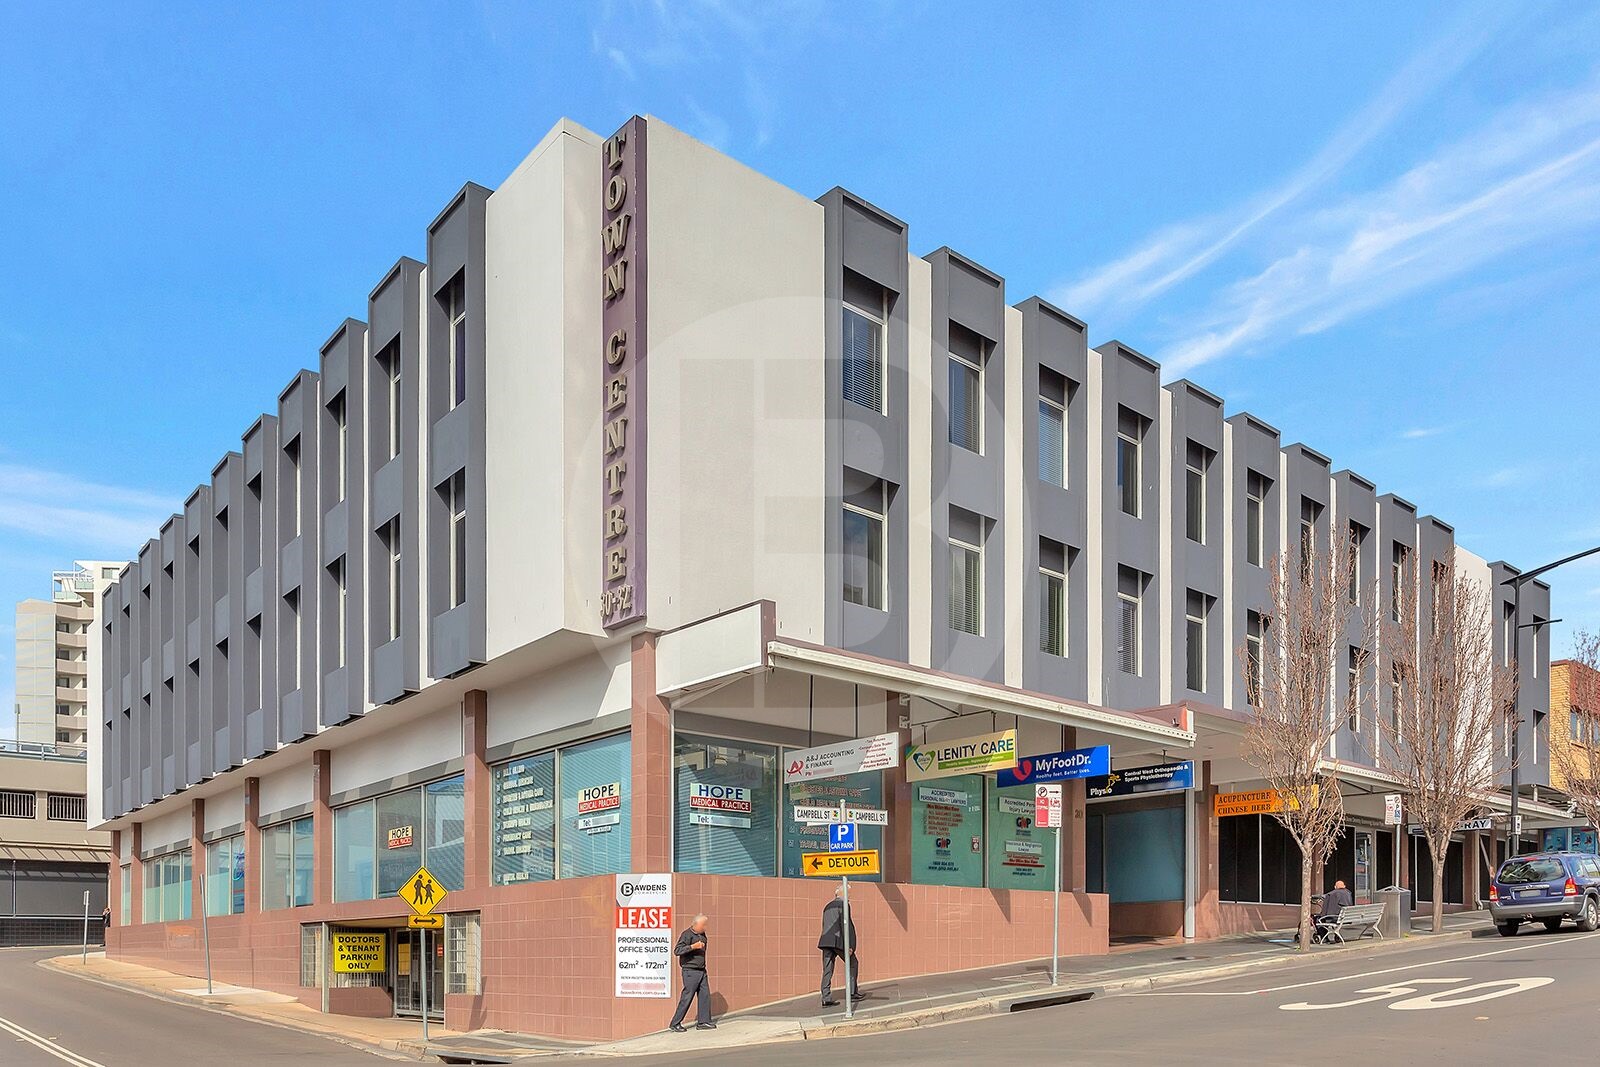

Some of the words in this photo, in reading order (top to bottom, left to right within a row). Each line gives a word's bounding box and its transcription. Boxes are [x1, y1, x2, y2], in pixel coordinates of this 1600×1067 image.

[601, 134, 631, 301] TOWN
[604, 328, 628, 582] CENTRE
[820, 749, 855, 760] ACCOUNTING
[937, 744, 977, 761] LENITY
[981, 738, 1014, 754] CARE
[810, 760, 833, 768] FINANCE
[1140, 772, 1174, 780] Physiotherapy
[584, 784, 614, 801] HOPE
[699, 784, 743, 800] HOPE
[1218, 792, 1271, 804] ACUPUNCTURE
[691, 797, 719, 807] MEDICAL
[721, 800, 749, 810] PRACTICE
[1218, 805, 1248, 814] CHINESE
[796, 809, 823, 819] CAMPBELL
[824, 810, 830, 819] ST
[855, 812, 879, 821] CAMPBELL
[879, 813, 885, 821] ST
[391, 826, 409, 838] HOPE
[837, 825, 849, 841] P
[828, 857, 870, 868] DETOUR
[619, 908, 669, 928] LEASE
[1278, 977, 1555, 1010] 50
